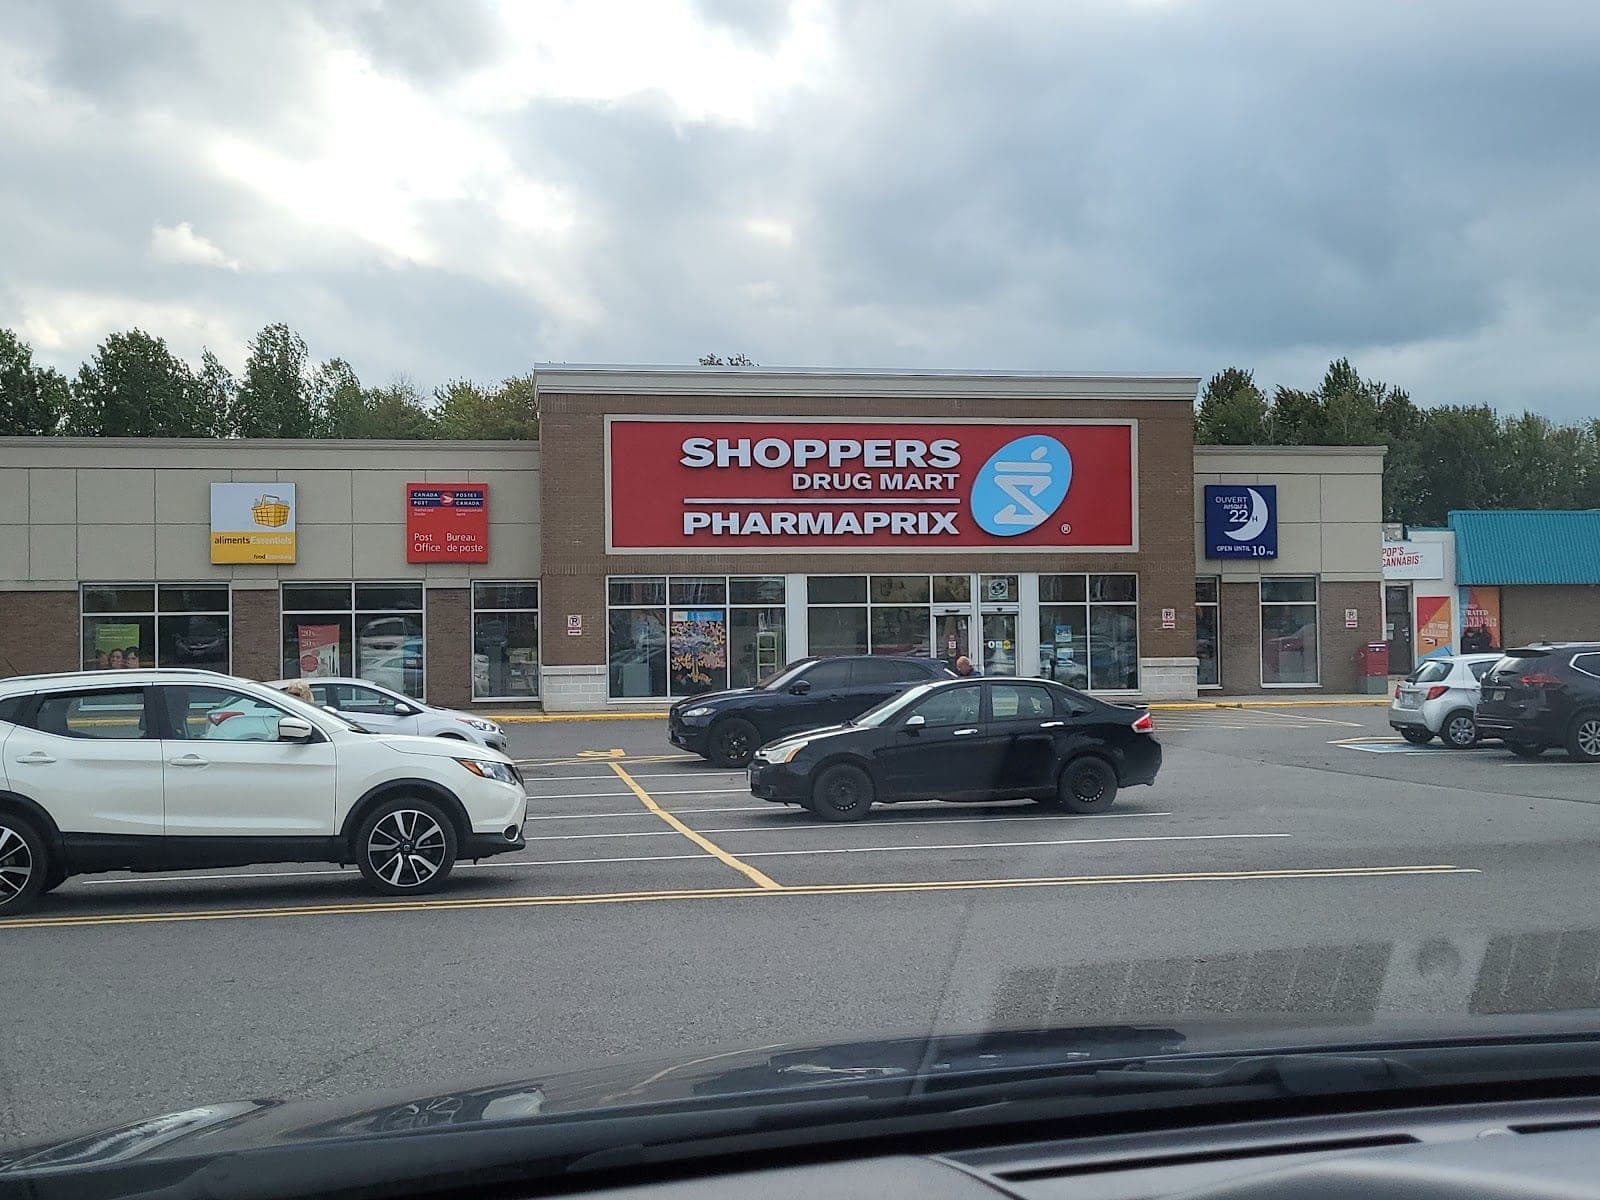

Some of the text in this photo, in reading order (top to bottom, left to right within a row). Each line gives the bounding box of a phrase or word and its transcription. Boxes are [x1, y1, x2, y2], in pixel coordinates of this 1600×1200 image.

[680, 438, 961, 468] SHOPPERS
[792, 473, 960, 490] DRUG MART
[1215, 496, 1248, 504] OUVERT
[1229, 510, 1249, 522] 22
[683, 511, 961, 535] PHARMAPRIX
[414, 532, 433, 542] Post
[446, 532, 476, 542] Bureau
[414, 543, 441, 552] Office
[447, 543, 484, 555] de poste
[1252, 545, 1266, 556] 10
[1382, 547, 1405, 556] POP'S
